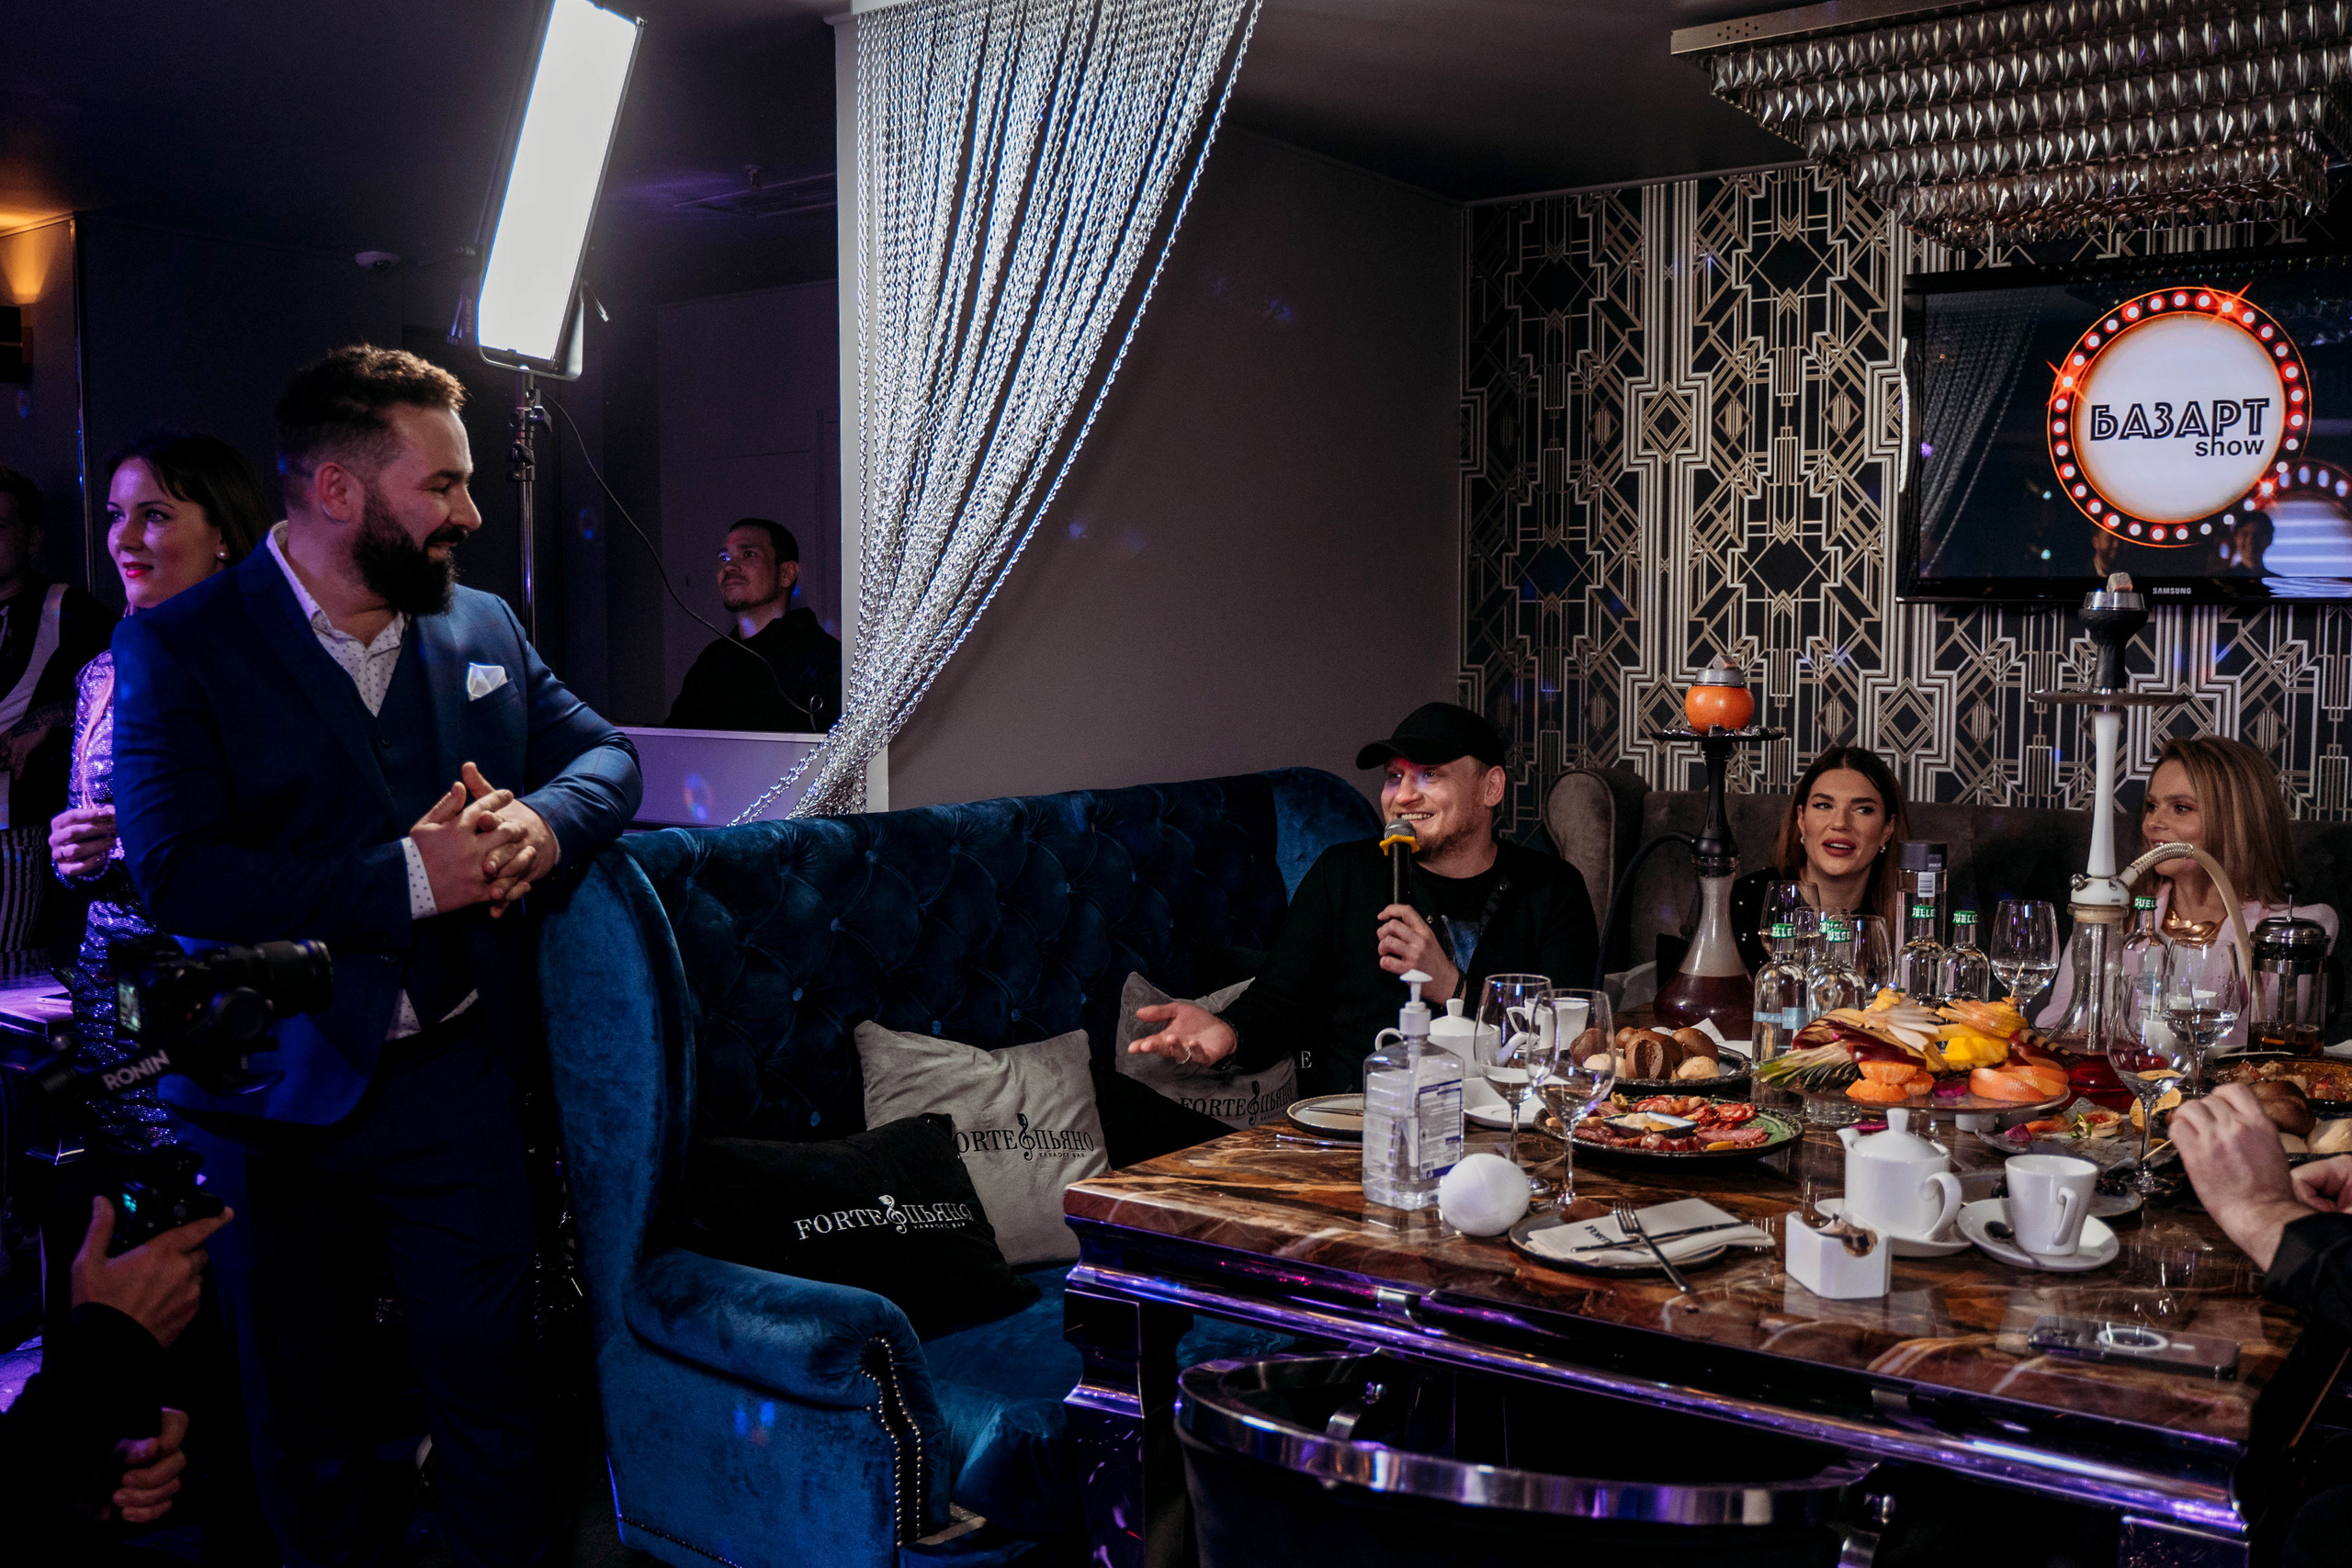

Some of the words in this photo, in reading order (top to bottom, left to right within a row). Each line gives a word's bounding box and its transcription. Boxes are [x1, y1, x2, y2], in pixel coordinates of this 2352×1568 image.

[2090, 398, 2270, 441] БАЗАРТ
[2195, 437, 2265, 457] show
[102, 1049, 171, 1090] RONIN
[952, 1129, 1018, 1154] ORTE
[1033, 1129, 1094, 1152] ПЬЯНО
[793, 1209, 888, 1241] FORTE
[901, 1203, 975, 1224] ПЬЯНО
